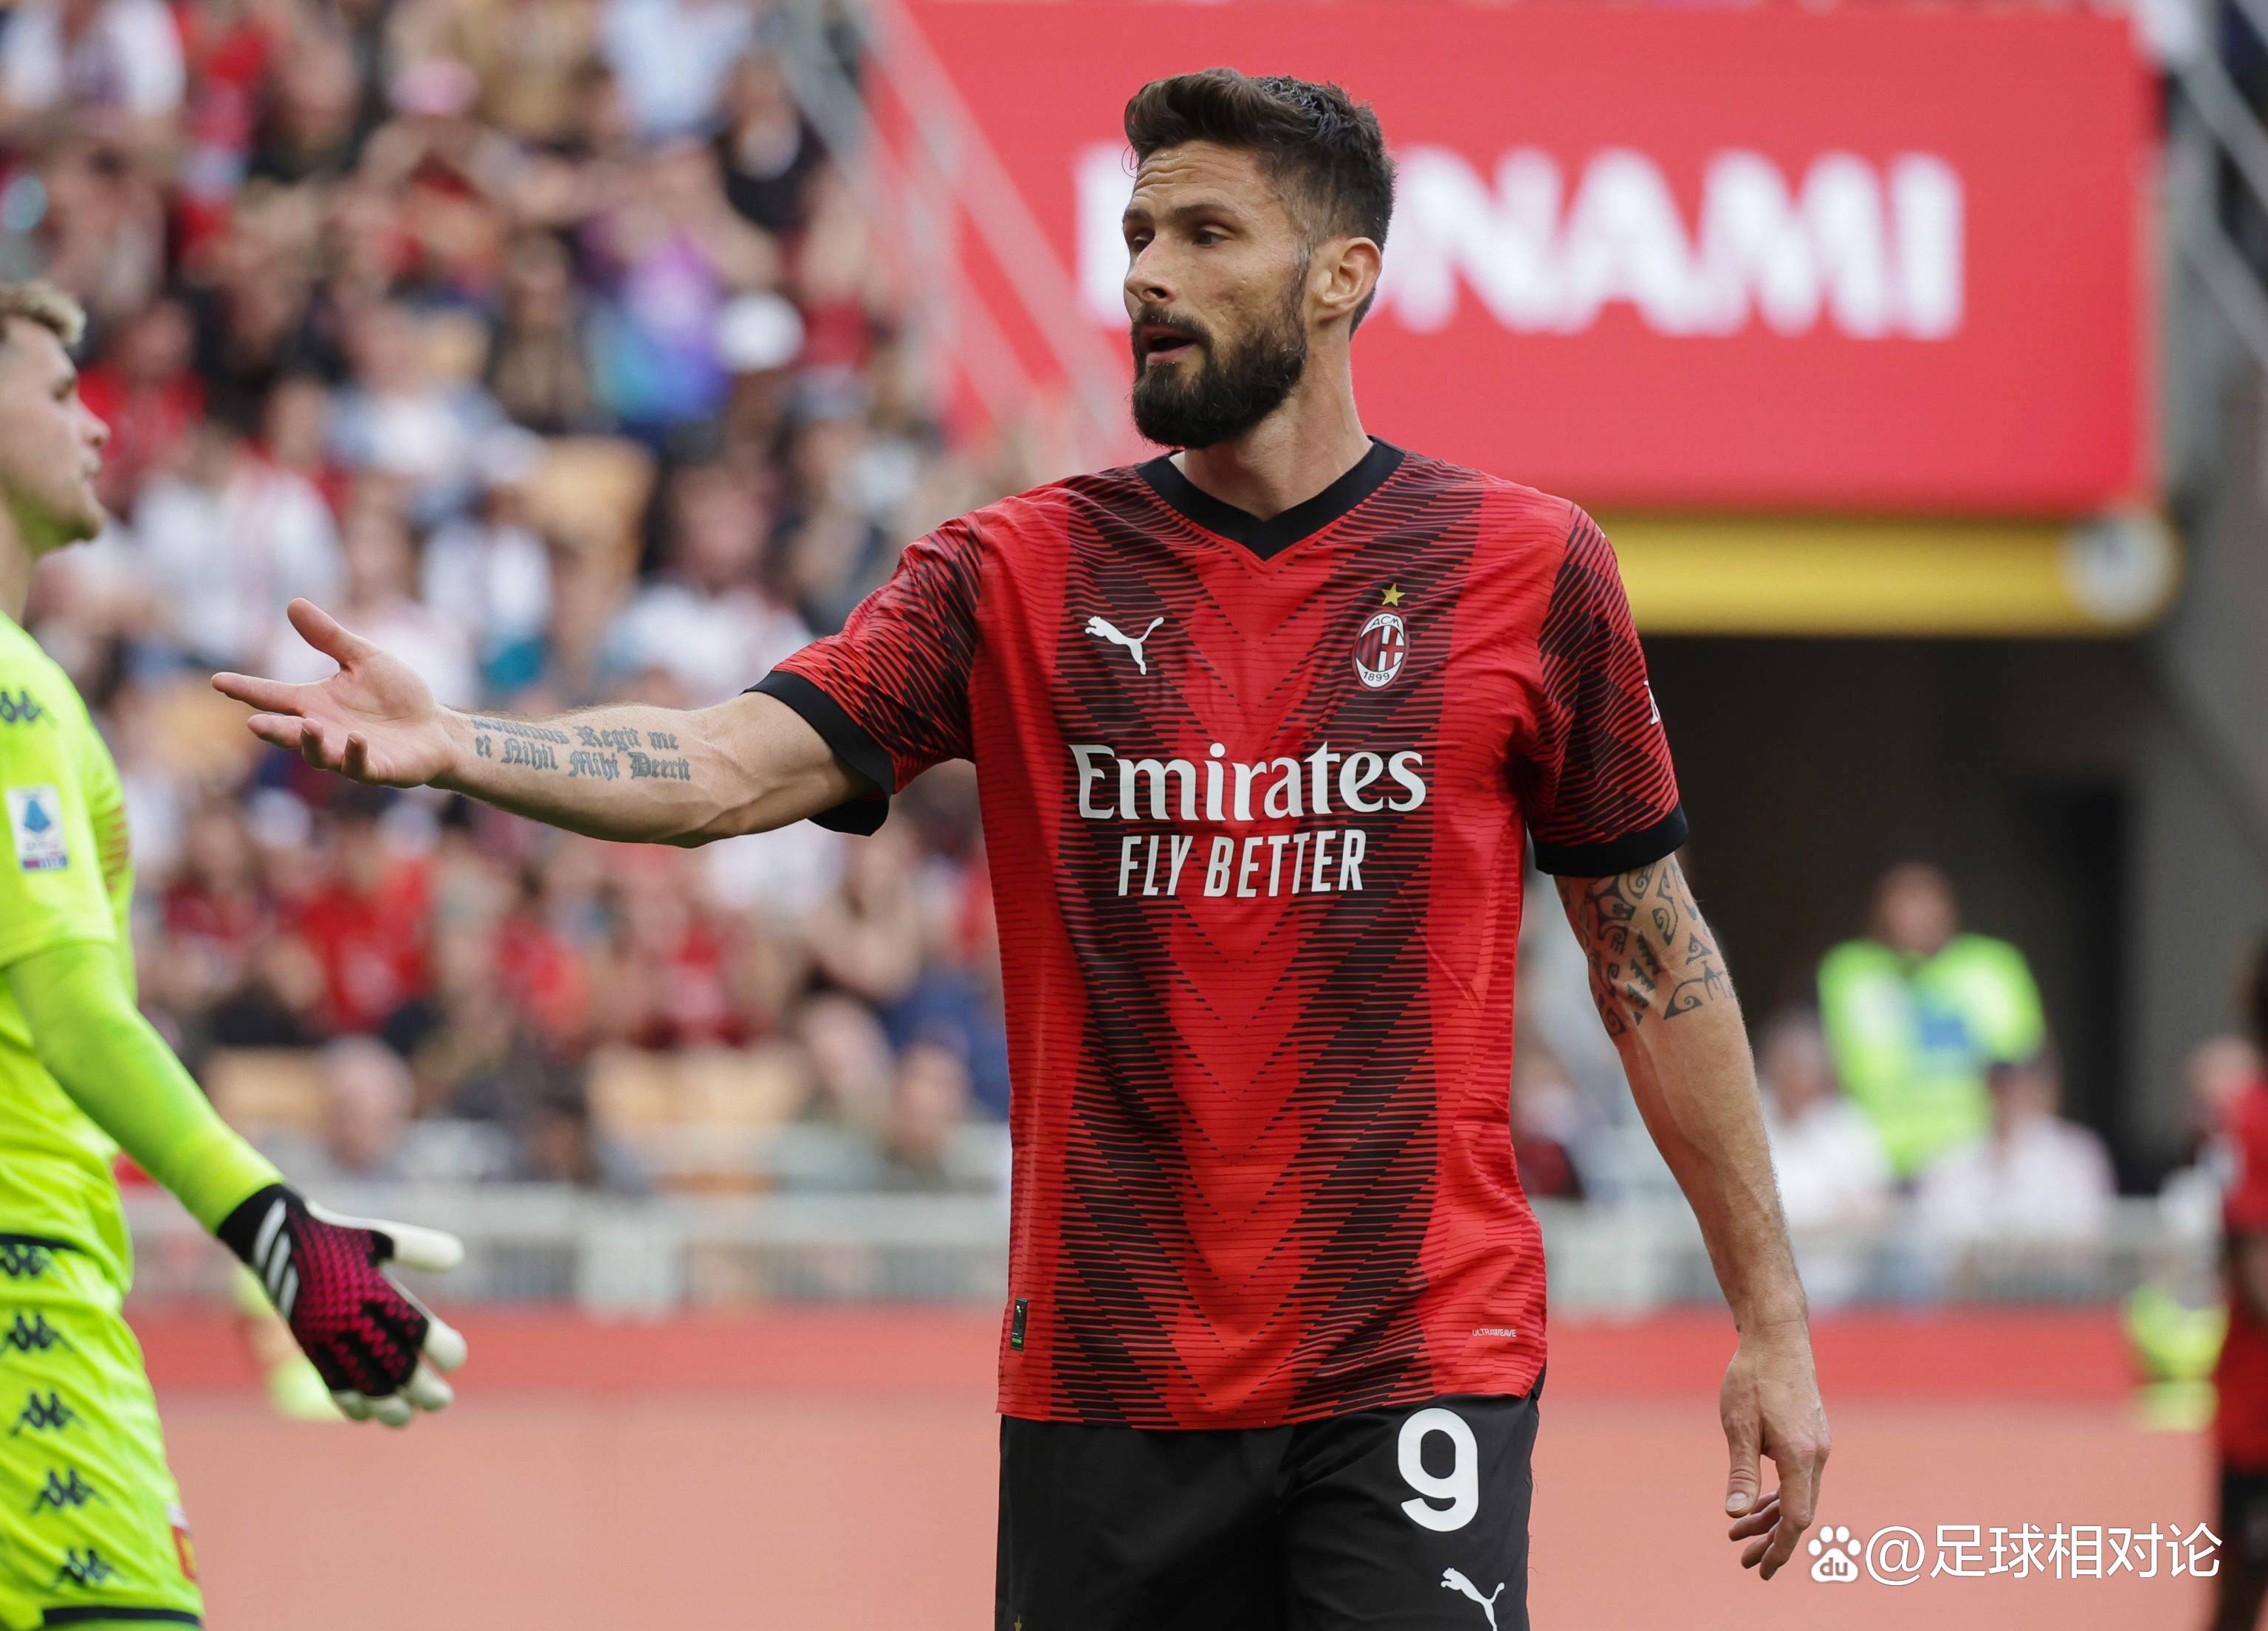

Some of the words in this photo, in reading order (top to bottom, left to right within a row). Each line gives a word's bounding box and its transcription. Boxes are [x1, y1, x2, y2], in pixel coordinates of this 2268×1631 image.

[1075, 142, 1964, 340] NAMI
[1370, 616, 1400, 628] ACM
[1364, 671, 1390, 681] 1899
[647, 731, 678, 750] me
[1068, 741, 1426, 821] Emirates
[1118, 834, 1193, 896] FLY
[1203, 829, 1367, 898] BETTER
[1472, 1328, 1517, 1337] ULTRAWEAVE
[1398, 1407, 1479, 1532] 9
